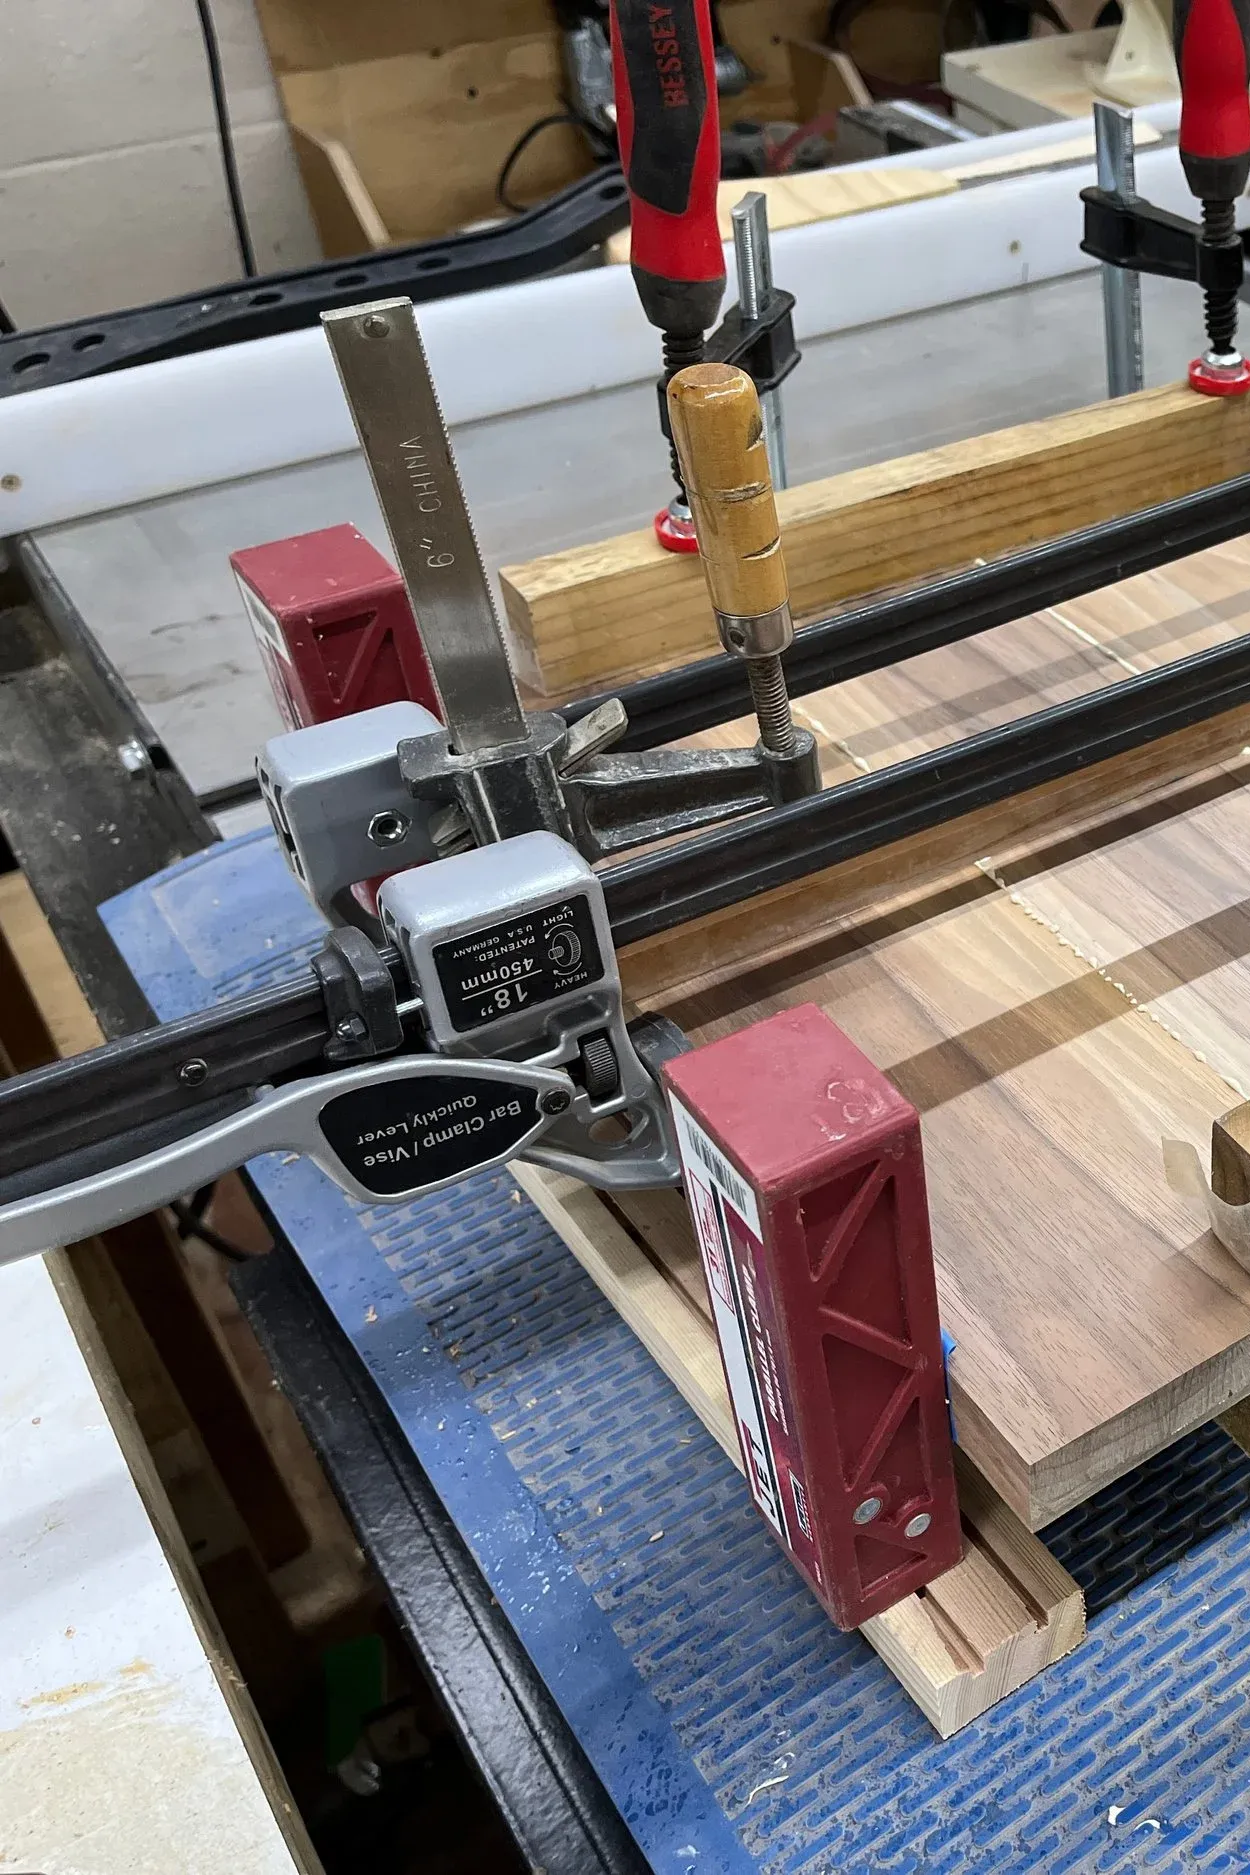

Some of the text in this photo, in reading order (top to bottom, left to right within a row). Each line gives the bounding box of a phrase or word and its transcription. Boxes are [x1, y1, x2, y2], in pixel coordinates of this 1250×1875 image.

[649, 5, 690, 108] BESSEY
[399, 434, 442, 514] CHINA
[543, 910, 574, 928] LIGHT
[453, 937, 500, 959] GERMANY
[474, 935, 536, 962] PATENTED:
[461, 958, 534, 991] 450mm
[553, 971, 588, 989] HEAVY
[357, 1095, 477, 1146] Quickly Lever
[488, 1100, 522, 1122] Bar
[423, 1117, 485, 1147] Clamp
[363, 1146, 411, 1168] Vise
[742, 1263, 762, 1333] CLAMP
[756, 1335, 779, 1422] PARALLEL
[747, 1427, 776, 1519] JET
